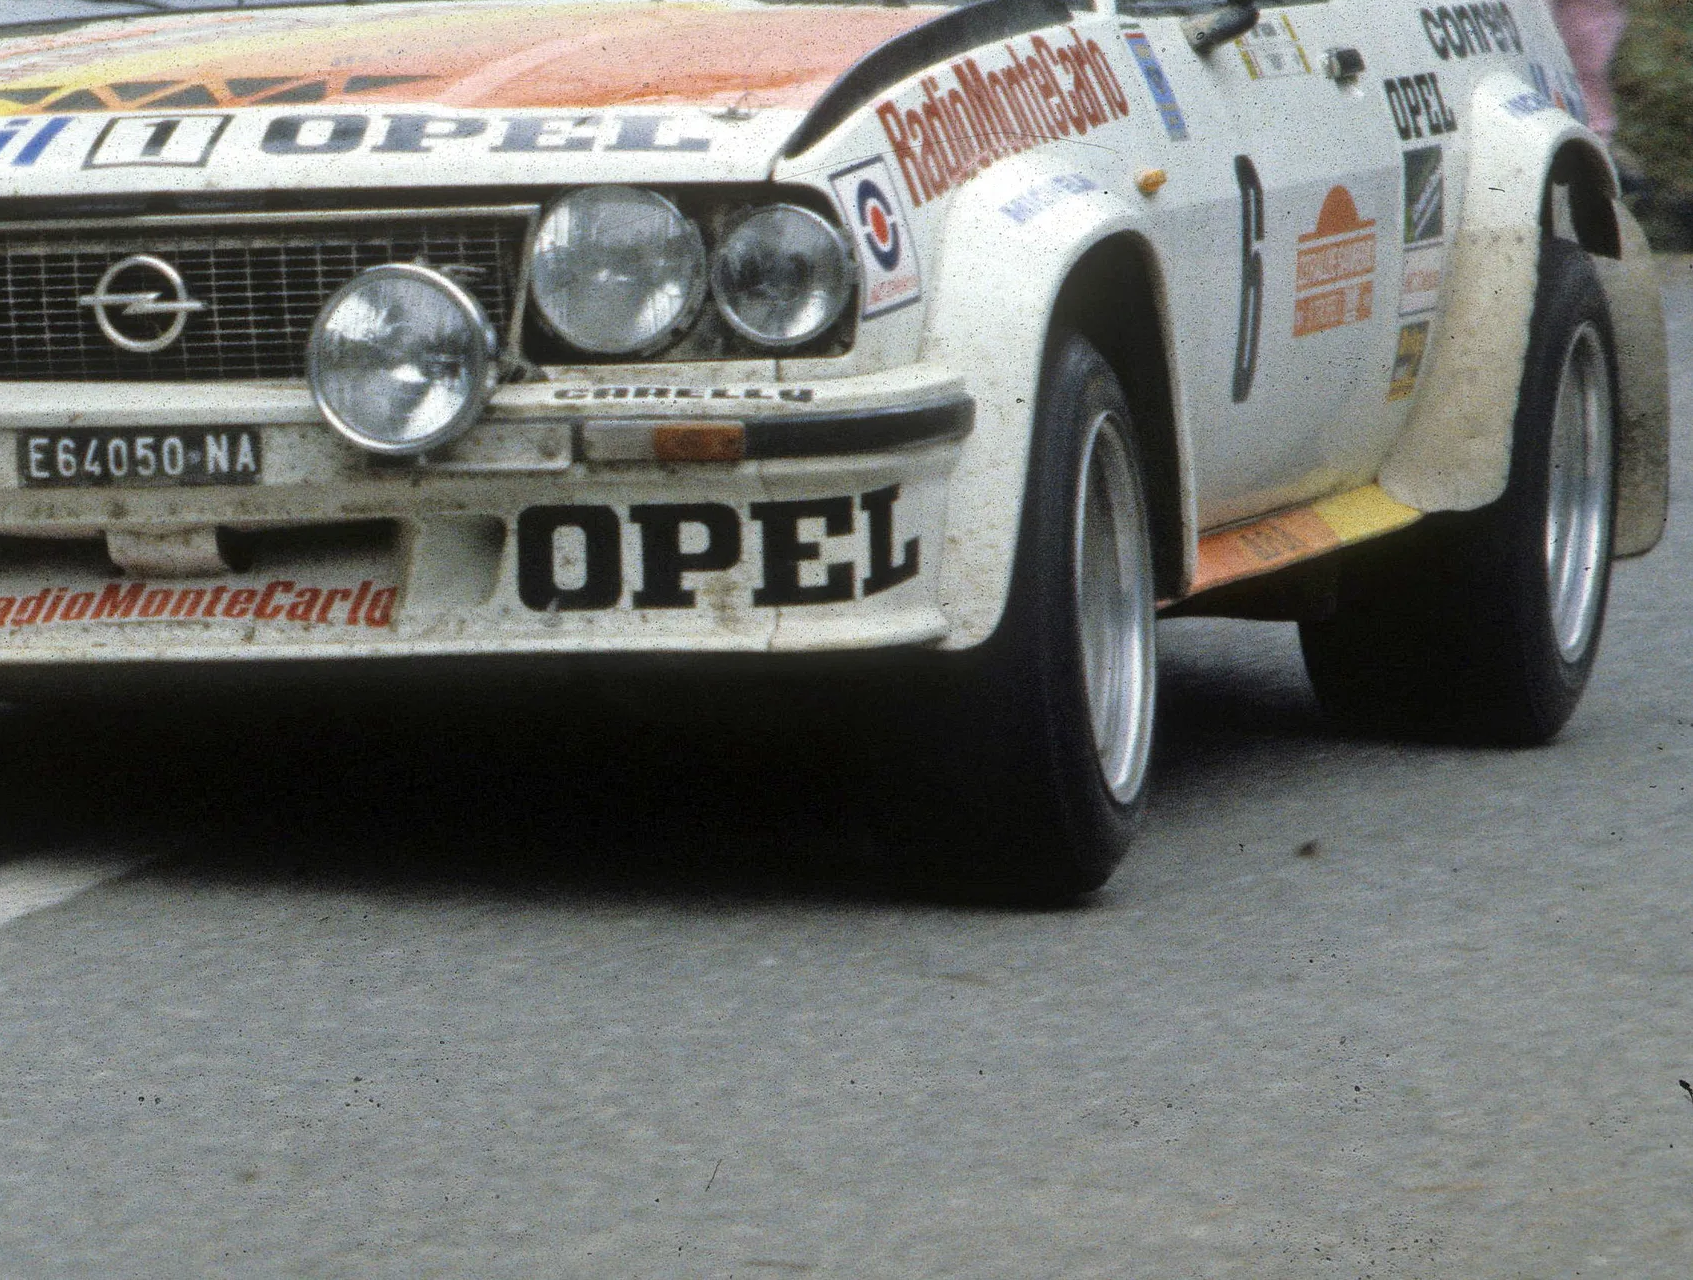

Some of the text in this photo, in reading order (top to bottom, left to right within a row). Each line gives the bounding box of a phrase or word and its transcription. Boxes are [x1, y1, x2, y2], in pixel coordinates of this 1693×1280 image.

[141, 122, 187, 157] 1
[260, 113, 712, 154] OPEL
[874, 24, 1130, 209] RadioMonteCarlo
[1384, 72, 1457, 141] OPEL
[27, 431, 258, 481] E64050 NA
[516, 484, 921, 612] OPEL
